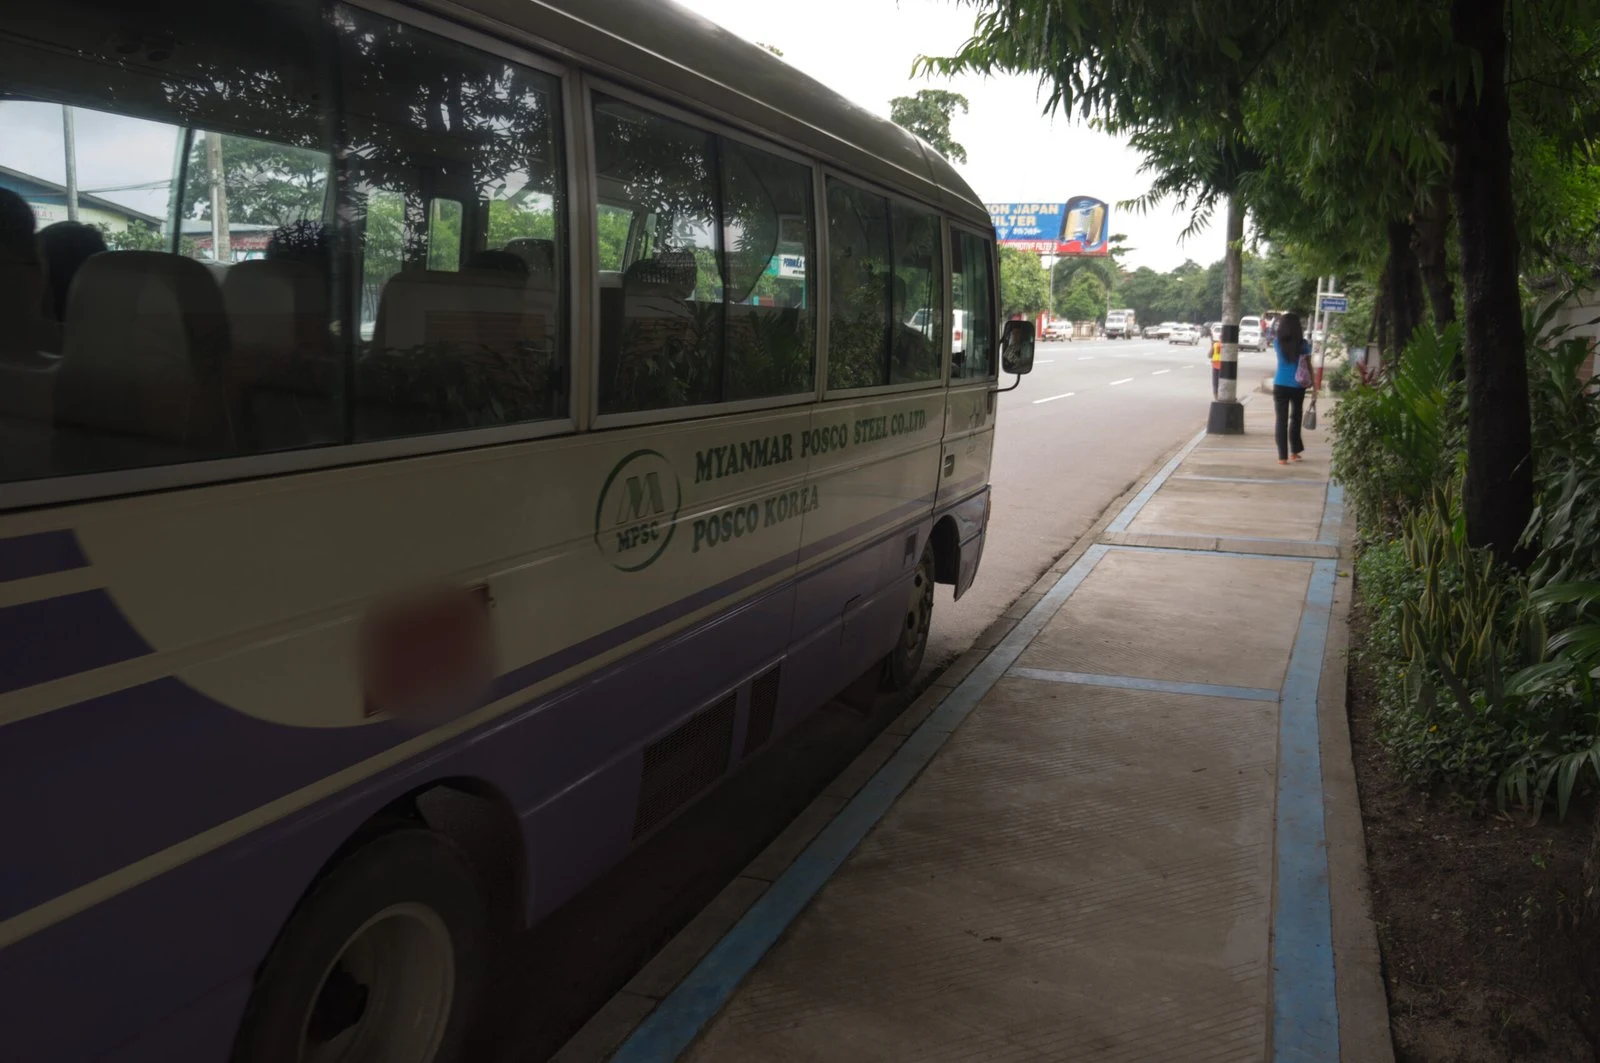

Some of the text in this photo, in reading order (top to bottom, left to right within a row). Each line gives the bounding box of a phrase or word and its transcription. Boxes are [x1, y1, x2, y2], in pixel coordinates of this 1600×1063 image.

[991, 215, 1036, 227] FILTER
[1013, 204, 1058, 214] JAPAN
[694, 433, 794, 485] MYANMAR
[800, 423, 848, 459] POSCO
[853, 415, 888, 444] STEEL
[692, 485, 820, 553] POSCO KOREA
[616, 520, 661, 553] MPSC
